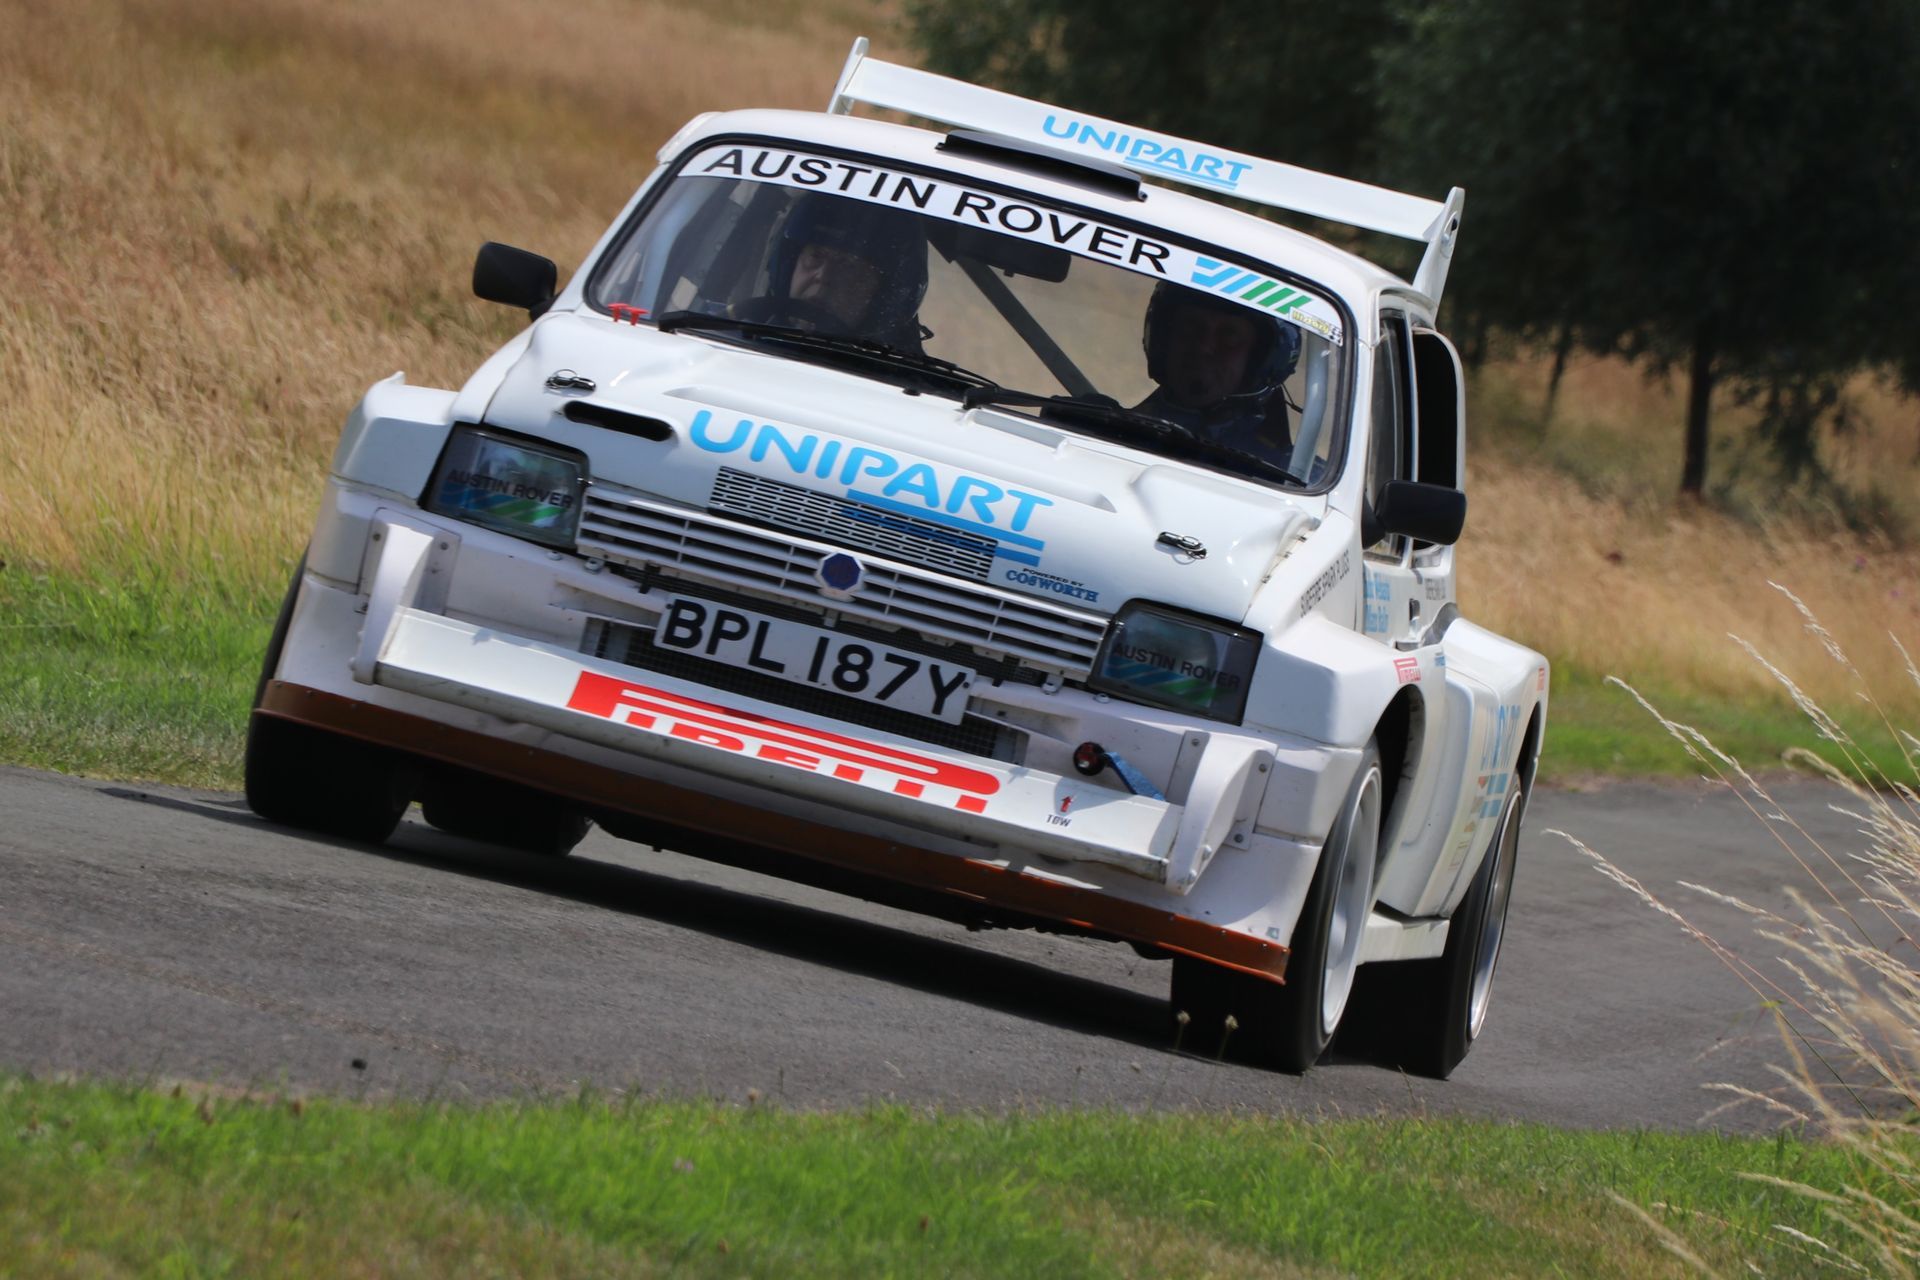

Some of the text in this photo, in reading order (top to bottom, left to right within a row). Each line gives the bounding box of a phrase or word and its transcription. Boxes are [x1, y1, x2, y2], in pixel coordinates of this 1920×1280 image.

[1042, 115, 1253, 181] UNIPART
[702, 149, 1170, 275] AUSTIN ROVER
[447, 469, 573, 509] AUSTIN ROVER
[689, 409, 1054, 532] UNIPART
[1006, 570, 1099, 602] COSWORTH
[1023, 568, 1069, 583] POWERED
[662, 599, 967, 715] BPL 187Y
[1113, 643, 1240, 688] AUSTIN ROVER
[1046, 814, 1072, 827] TOW
